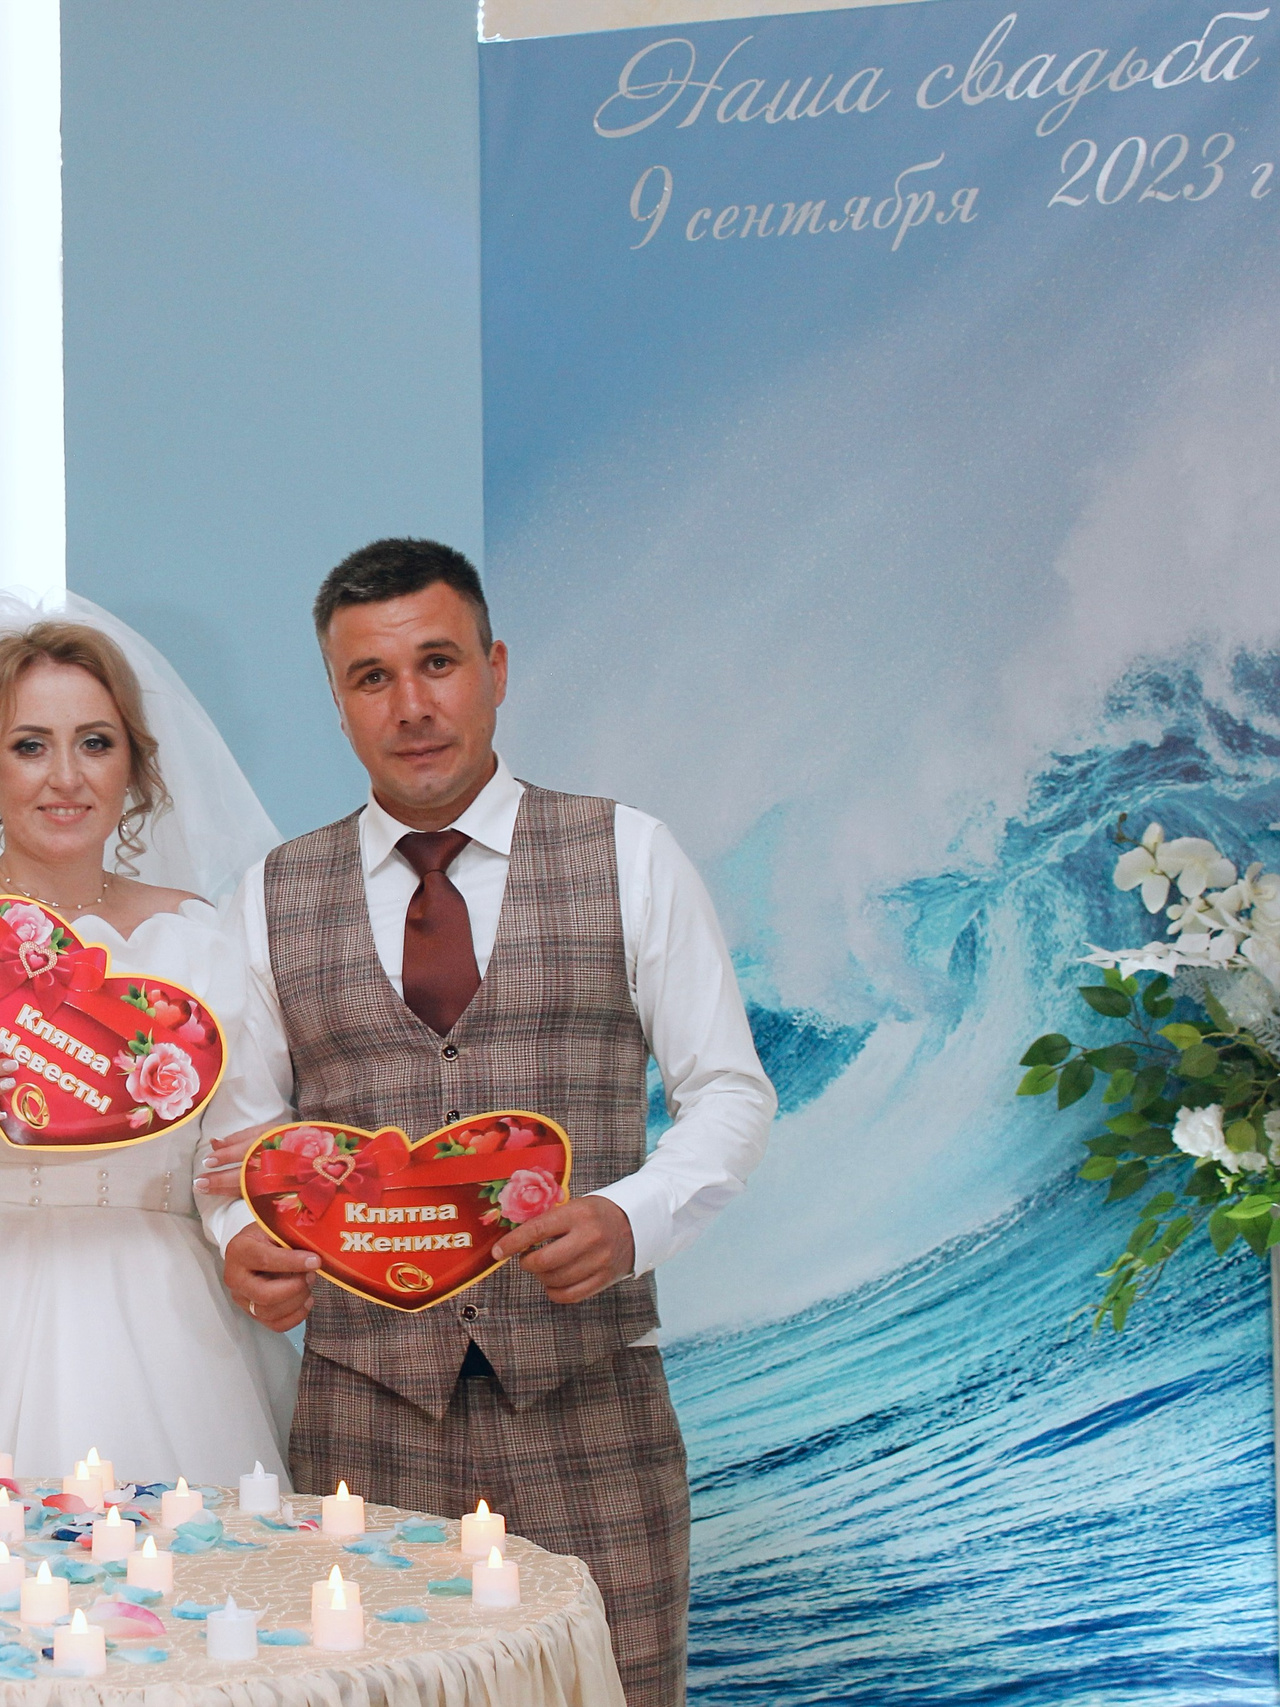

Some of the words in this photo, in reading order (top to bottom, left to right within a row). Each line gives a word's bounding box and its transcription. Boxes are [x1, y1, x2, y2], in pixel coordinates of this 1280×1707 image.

[593, 35, 891, 138] Наша
[915, 7, 1270, 138] свадьба
[629, 165, 673, 250] 9
[684, 151, 980, 252] сентября
[1046, 132, 1235, 209] 2023
[14, 1003, 113, 1077] Клятва
[340, 1230, 472, 1253] Жениха
[344, 1202, 459, 1224] Клятва
